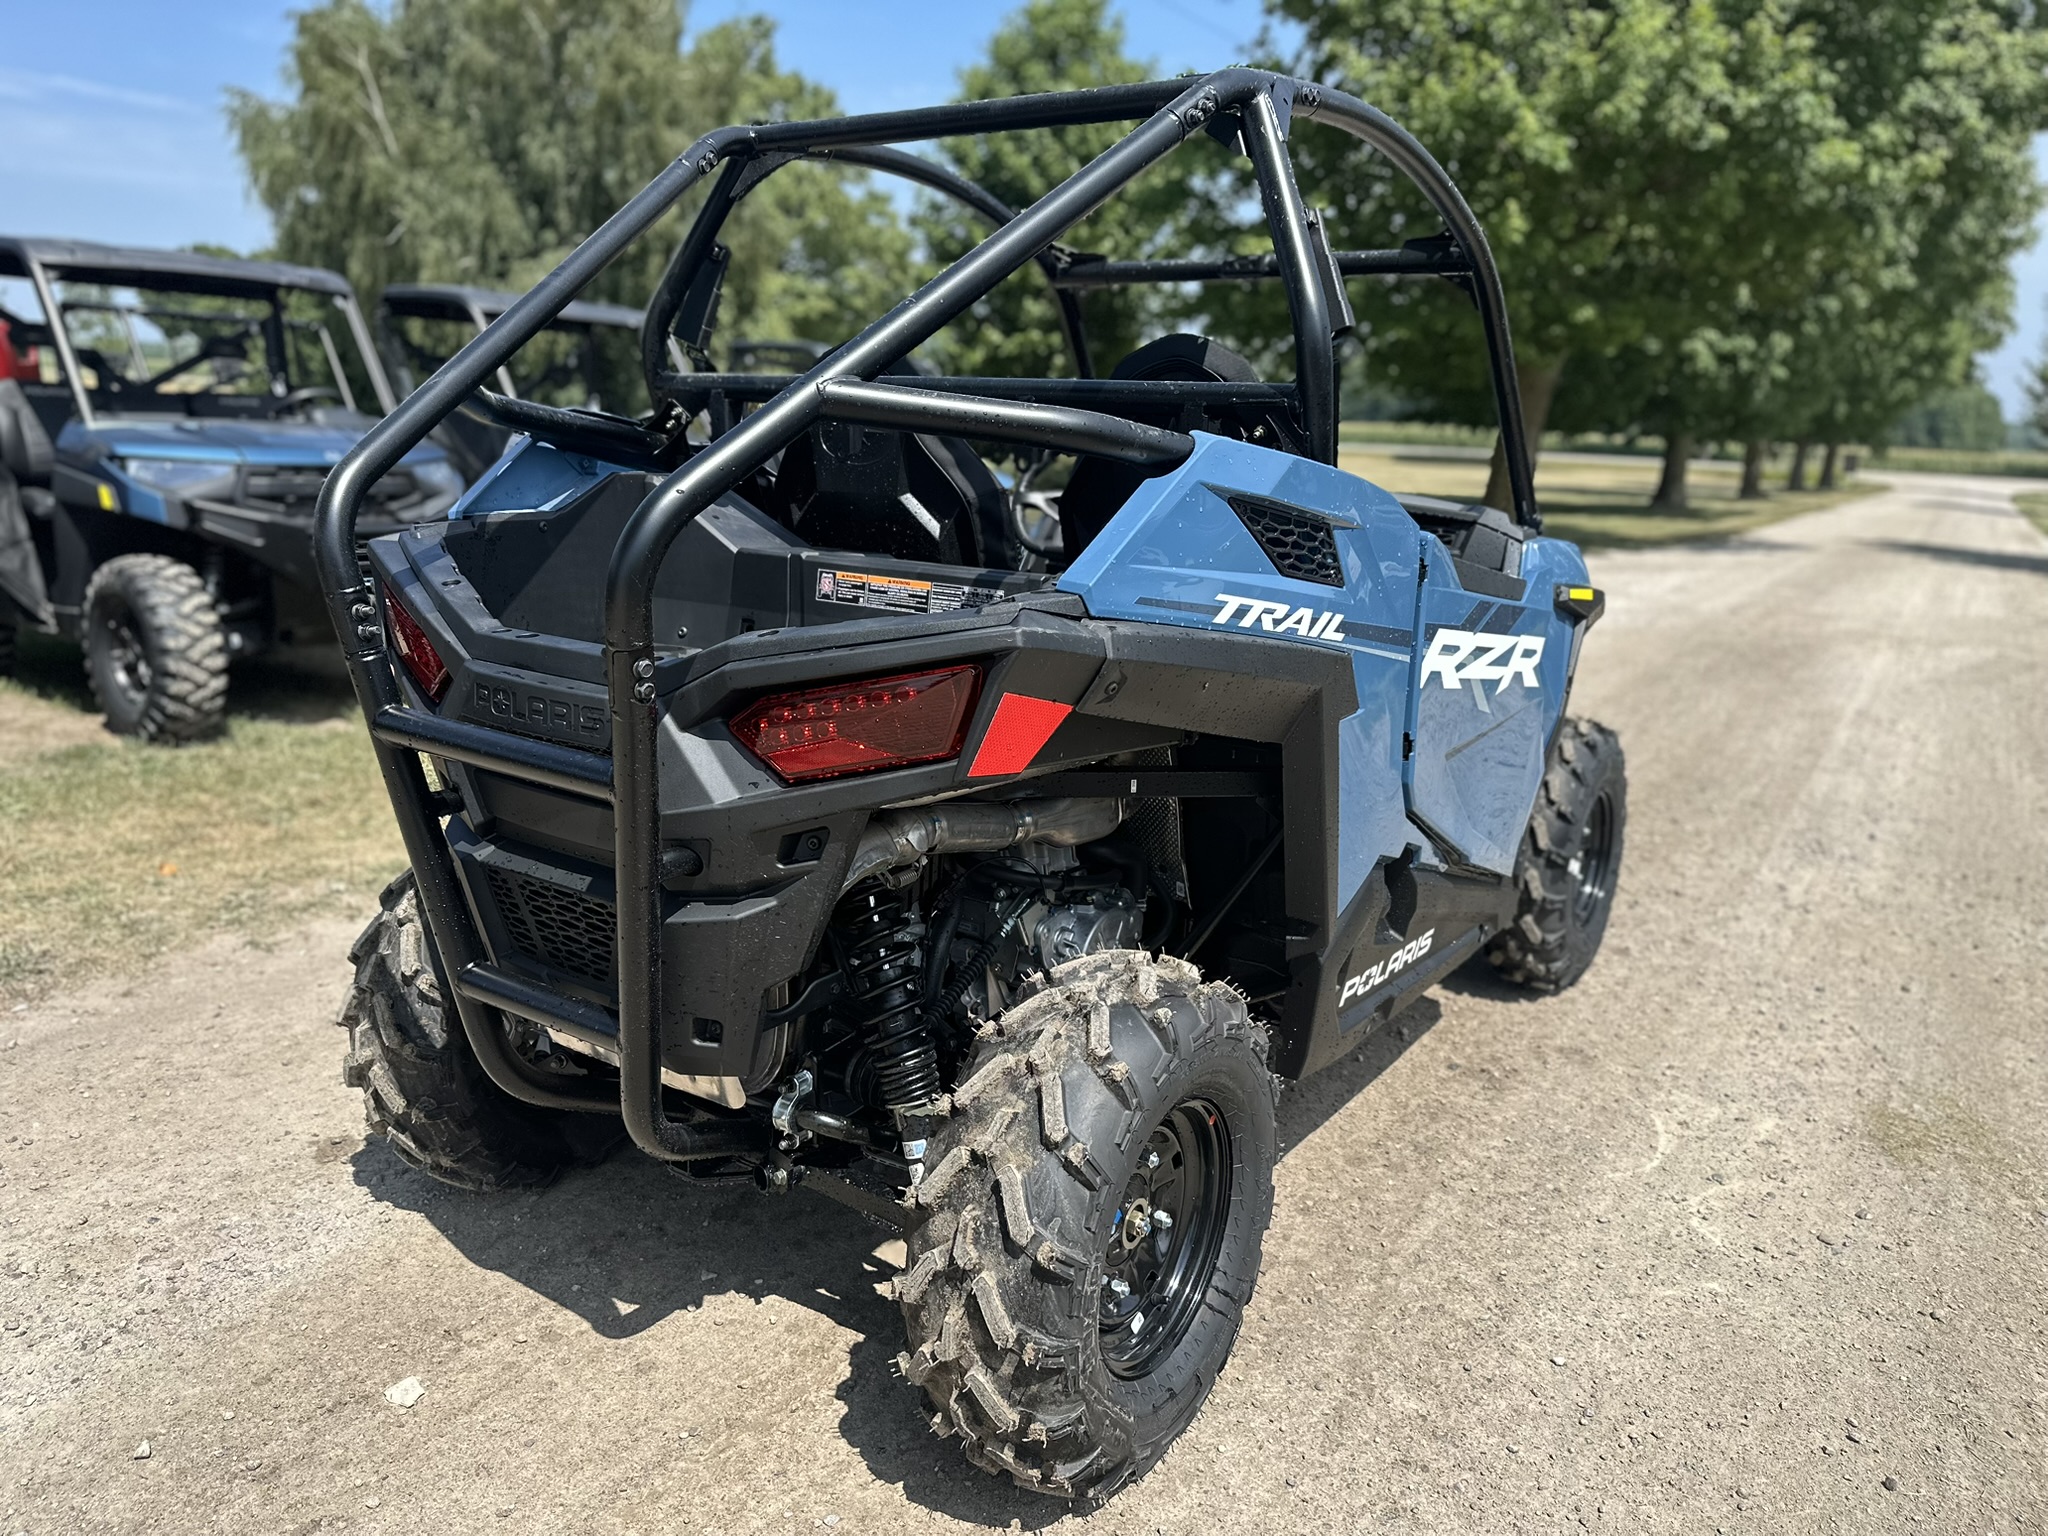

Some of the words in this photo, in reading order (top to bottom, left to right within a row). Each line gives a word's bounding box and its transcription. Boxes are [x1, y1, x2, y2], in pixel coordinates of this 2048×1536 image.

[1212, 593, 1346, 642] TRAIL
[1420, 628, 1546, 696] RZR
[474, 681, 605, 738] POLARIS
[1339, 928, 1435, 1008] POLARIS
